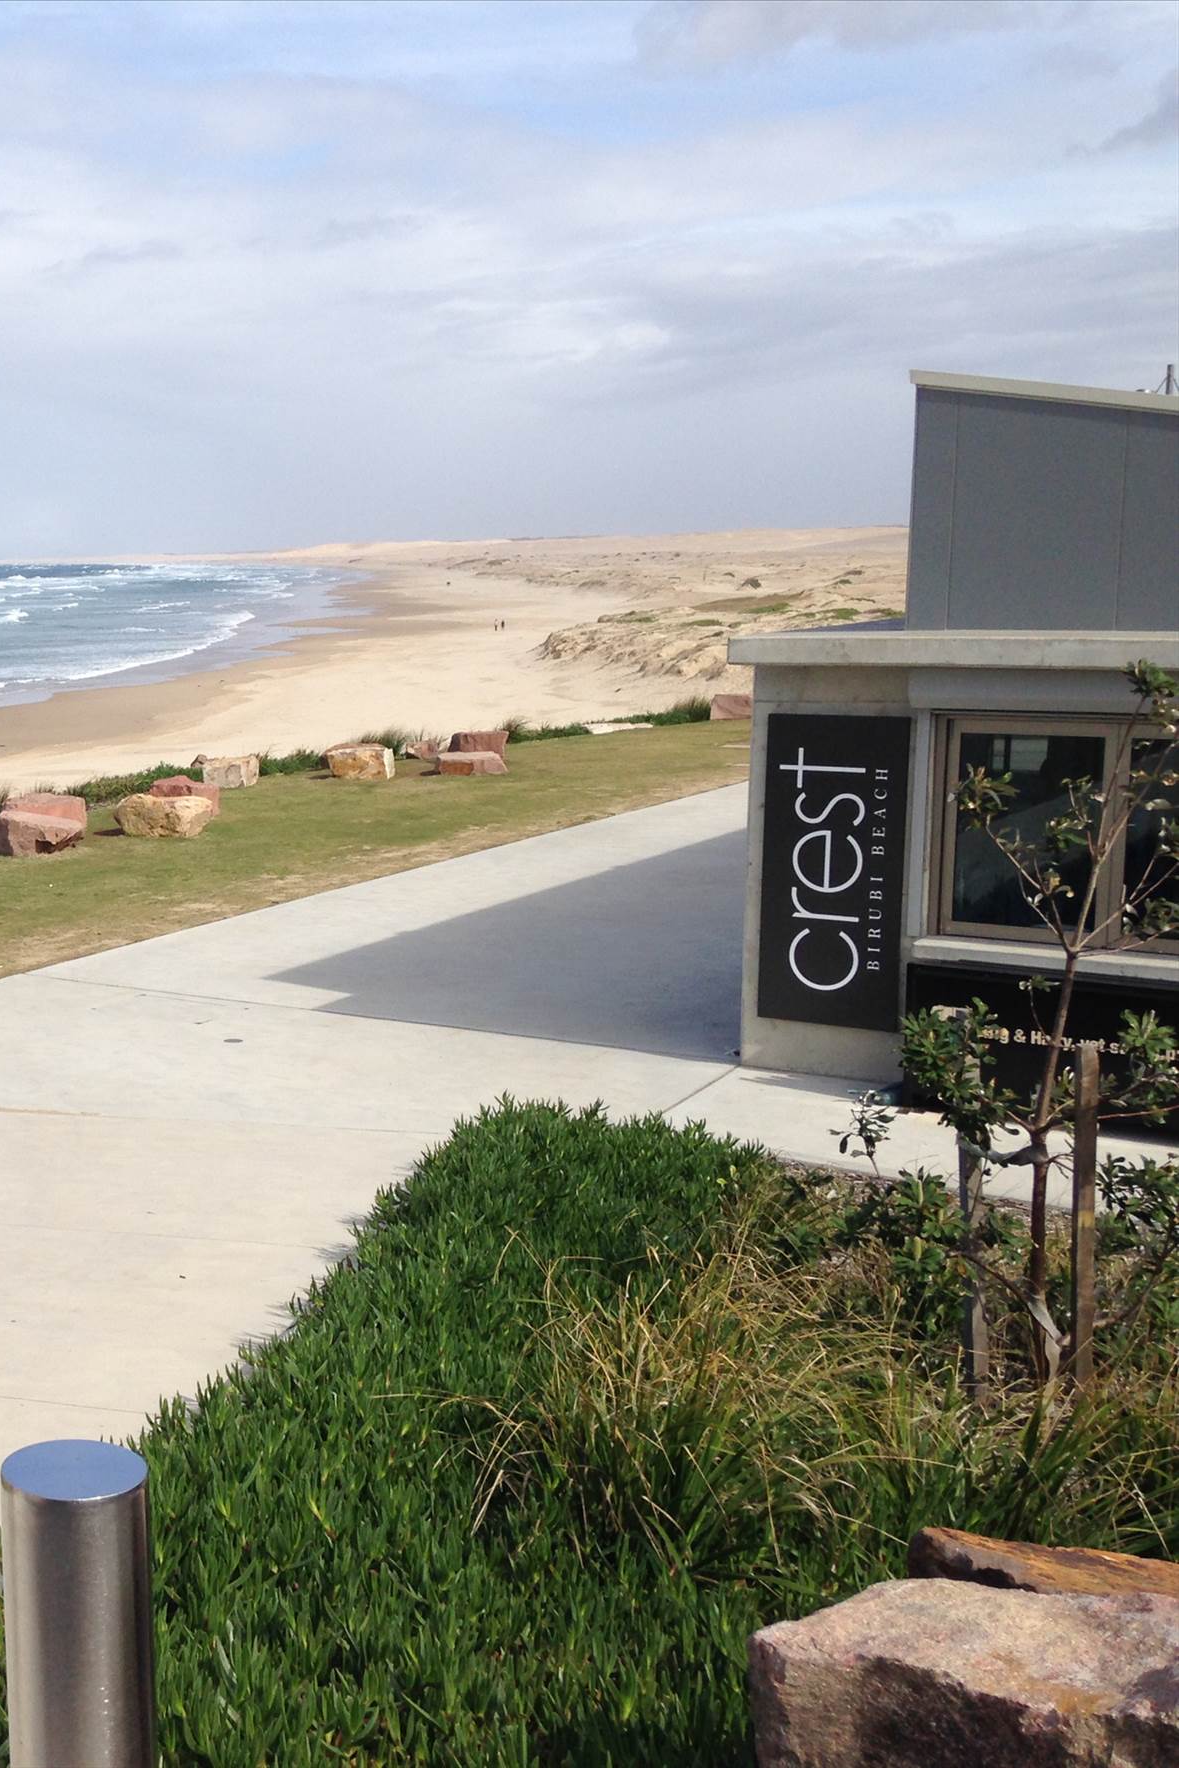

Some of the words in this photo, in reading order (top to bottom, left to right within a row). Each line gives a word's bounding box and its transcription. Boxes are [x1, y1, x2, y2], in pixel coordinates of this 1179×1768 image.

[871, 769, 889, 856] BEACH
[779, 747, 867, 991] crest
[867, 876, 883, 971] BIRUBI
[1013, 1028, 1027, 1044] &
